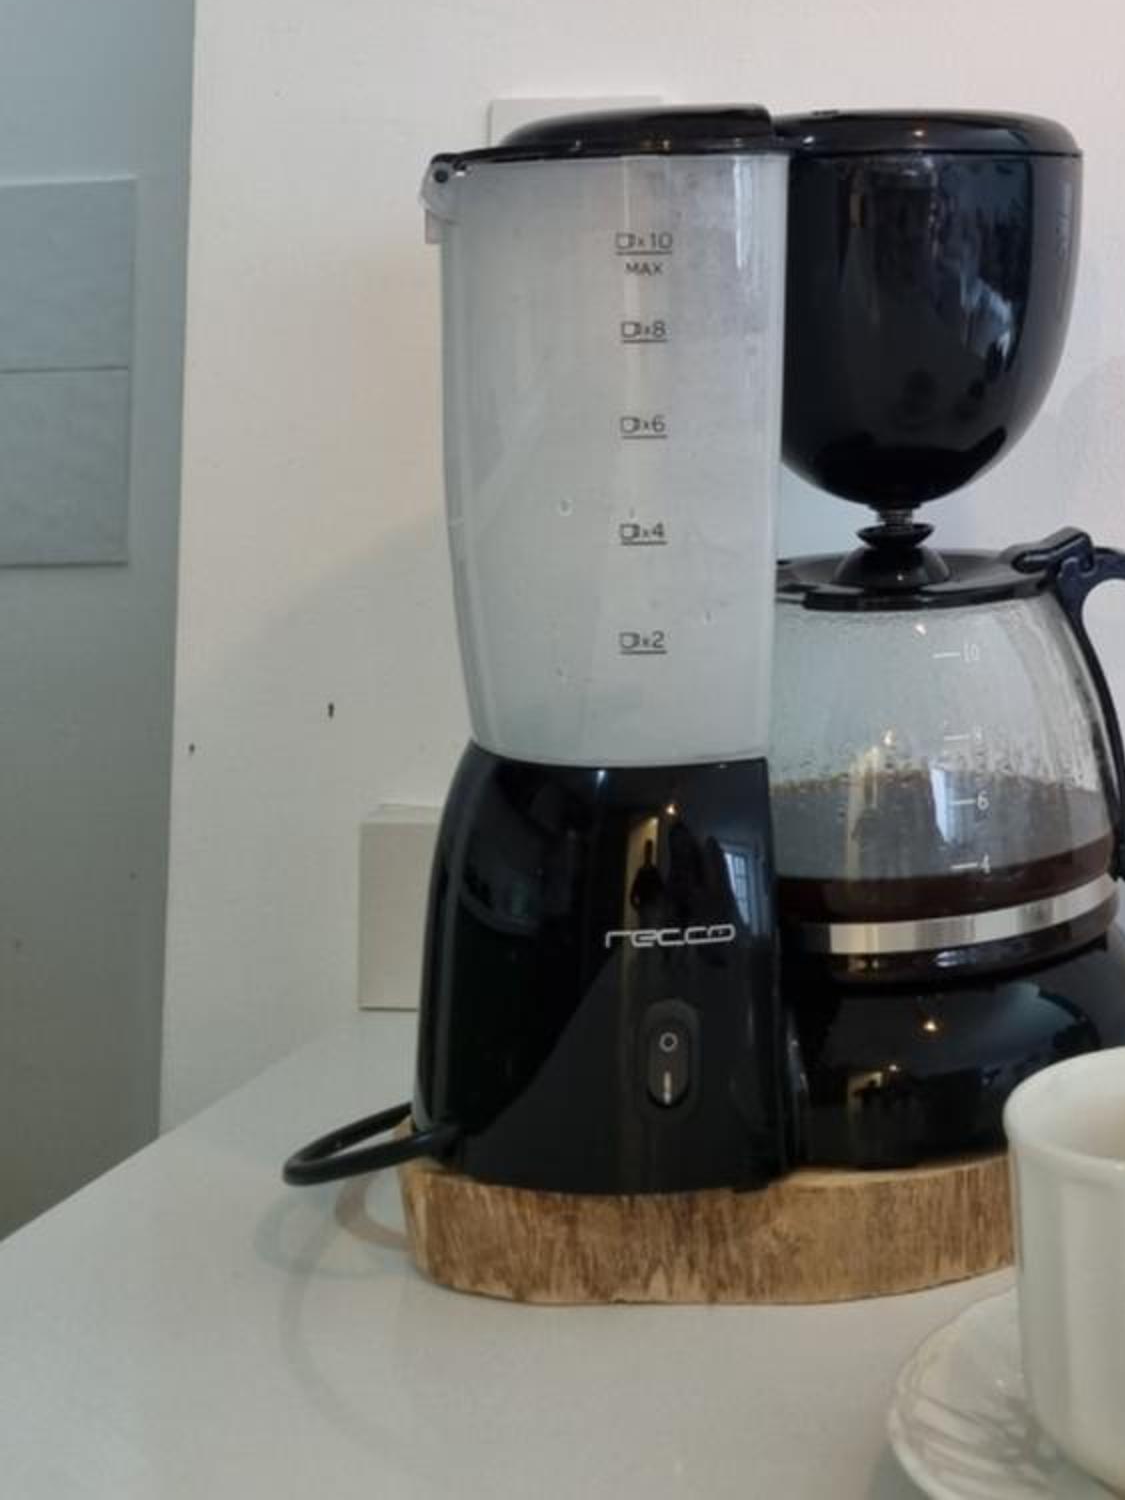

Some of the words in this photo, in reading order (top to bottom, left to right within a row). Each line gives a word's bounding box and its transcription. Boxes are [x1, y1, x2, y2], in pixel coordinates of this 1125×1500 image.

[625, 262, 663, 276] MAX
[963, 643, 980, 662] 10
[977, 790, 989, 811] 6
[980, 854, 991, 874] 4
